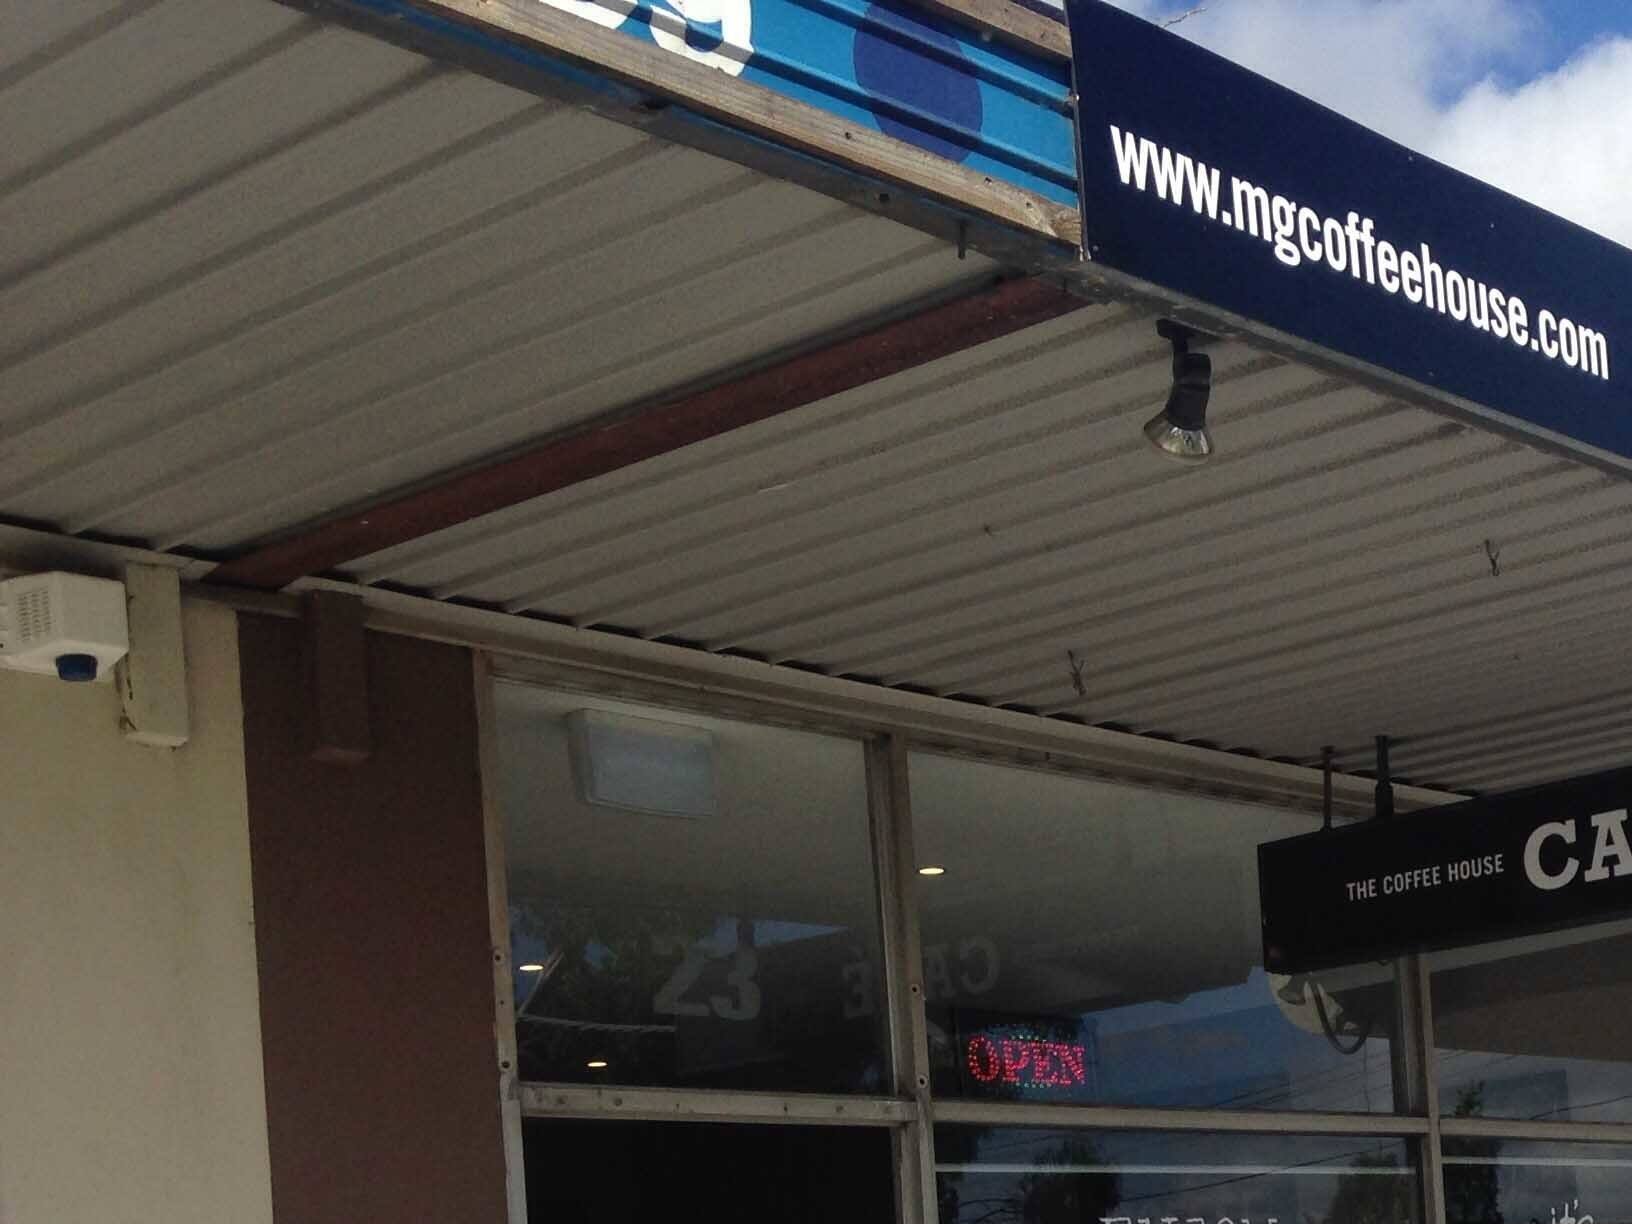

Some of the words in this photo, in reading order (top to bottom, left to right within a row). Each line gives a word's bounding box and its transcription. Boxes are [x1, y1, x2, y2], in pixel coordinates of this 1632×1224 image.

[1109, 124, 1610, 380] www.mgcoffeehouse.com
[1347, 877, 1378, 901] THE
[1382, 863, 1442, 895] COFFEE
[1447, 853, 1504, 885] HOUSE
[966, 1032, 1086, 1087] OPEN
